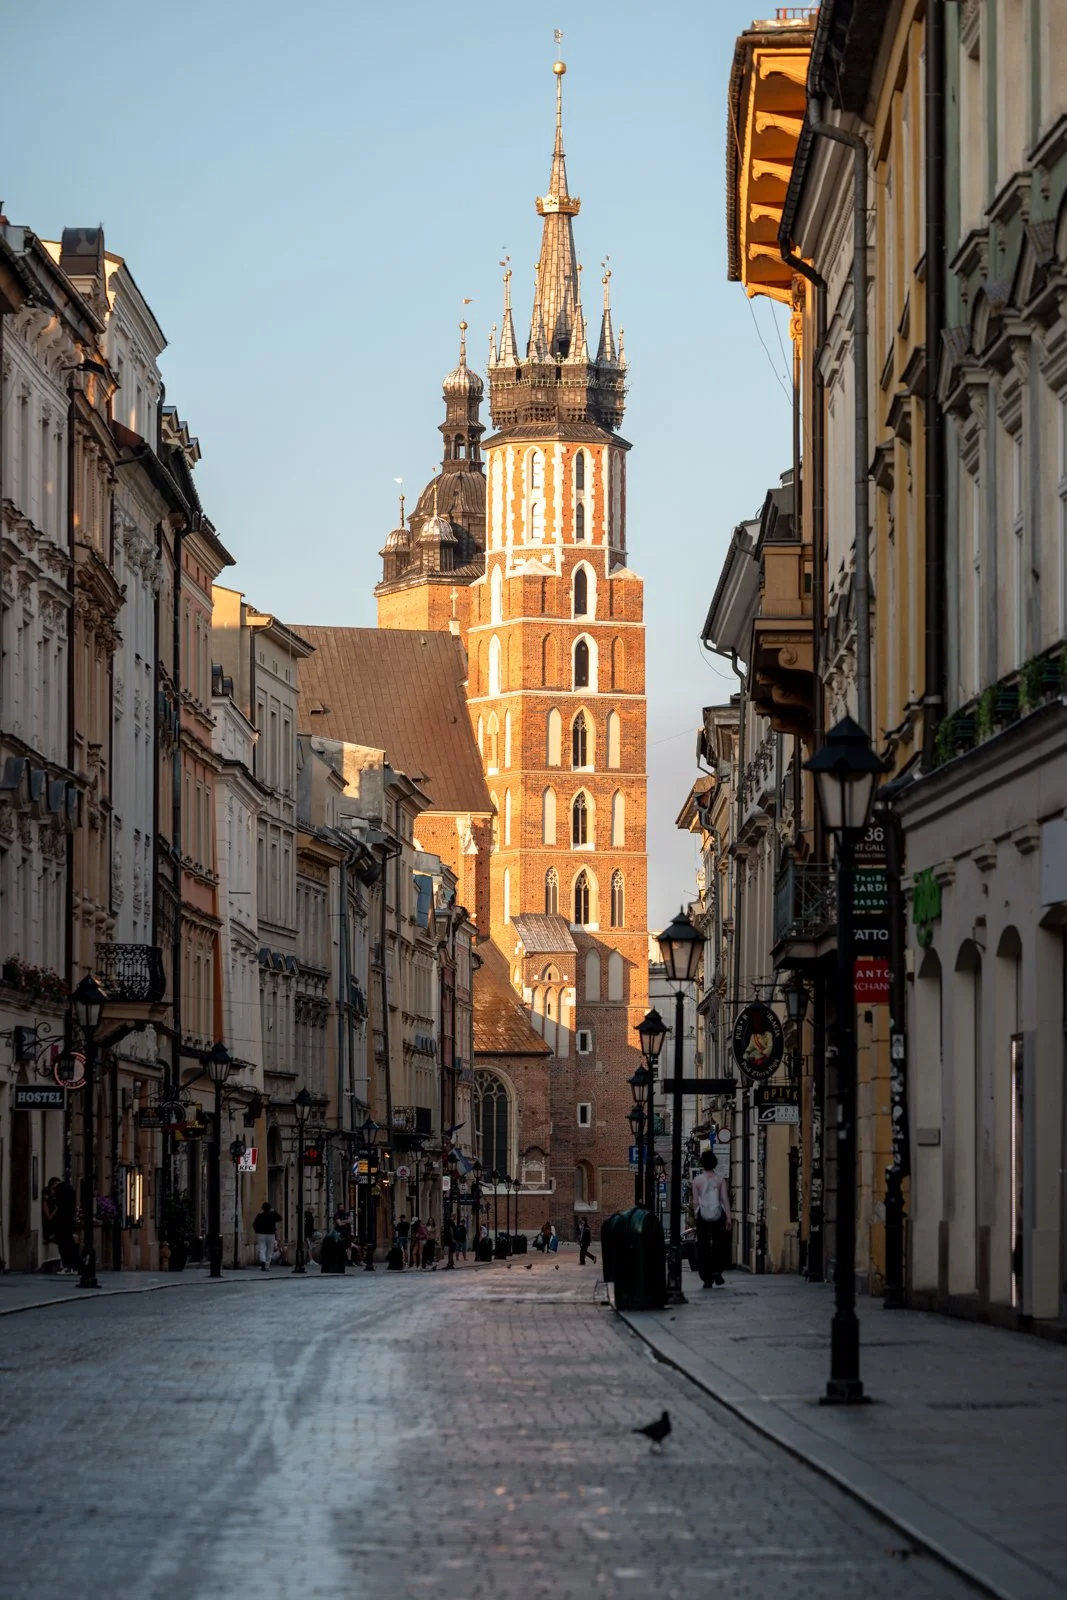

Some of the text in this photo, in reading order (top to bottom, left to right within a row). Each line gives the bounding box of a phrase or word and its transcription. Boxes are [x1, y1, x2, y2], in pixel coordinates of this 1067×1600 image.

[864, 827, 884, 842] 36
[852, 929, 889, 941] ATTO
[17, 1091, 62, 1103] HOSTEL
[763, 1088, 798, 1100] OPTYK
